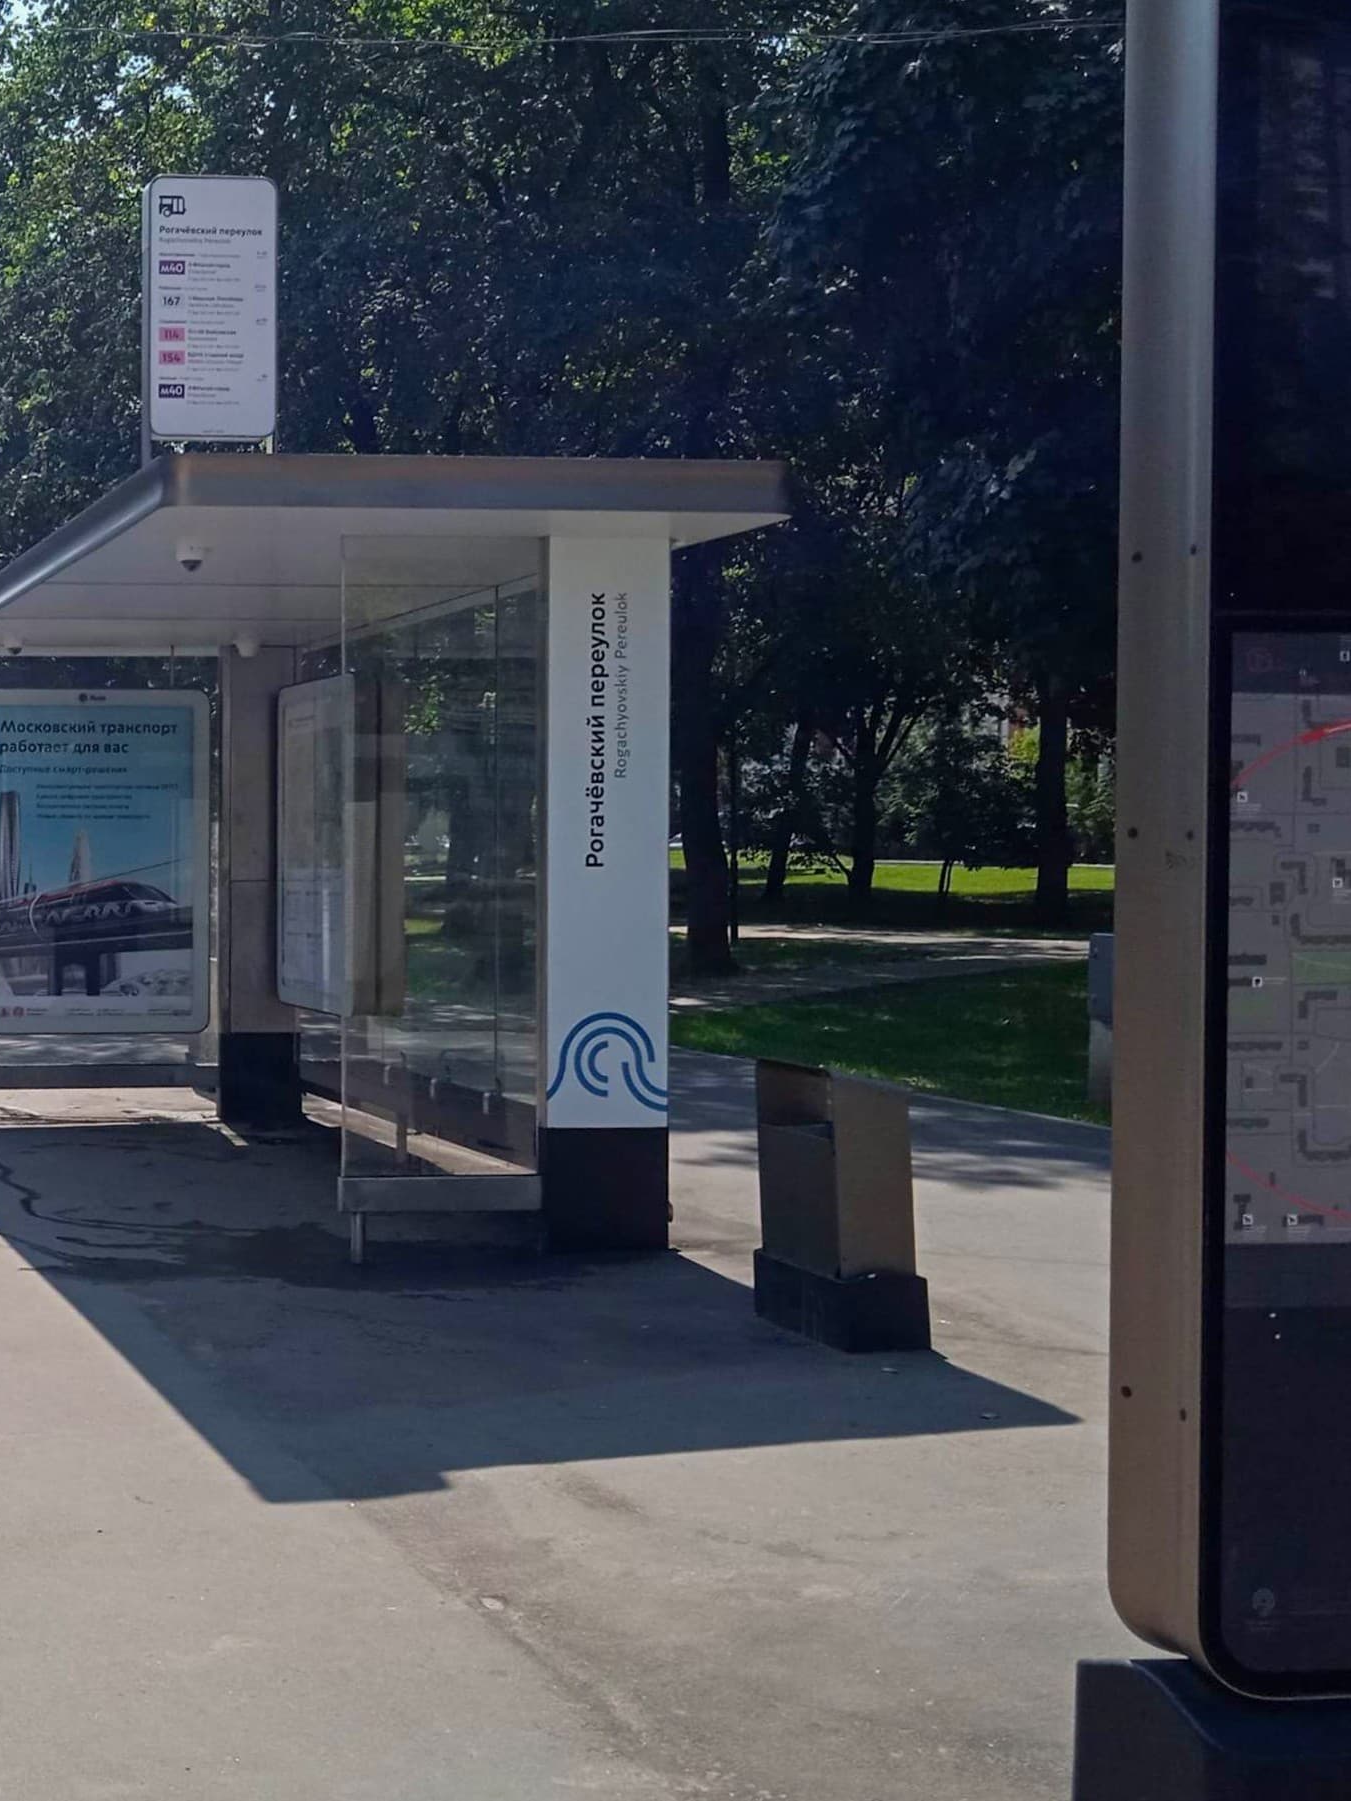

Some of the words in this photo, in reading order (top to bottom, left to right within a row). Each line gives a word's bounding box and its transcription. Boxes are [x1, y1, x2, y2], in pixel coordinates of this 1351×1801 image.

[159, 225, 217, 237] Рогачёвский
[219, 228, 263, 238] переулок
[162, 296, 181, 306] 167
[163, 329, 180, 340] 114
[162, 353, 181, 364] 154
[614, 592, 627, 659] Pereulok
[590, 592, 610, 707] переулок
[0, 720, 96, 734] Московский
[100, 724, 177, 736] транспорт
[614, 665, 629, 779] Rogachyovskiy
[0, 740, 69, 755] работает
[73, 743, 99, 755] для
[104, 743, 129, 753] вас
[584, 714, 604, 868] Рогачёвский
